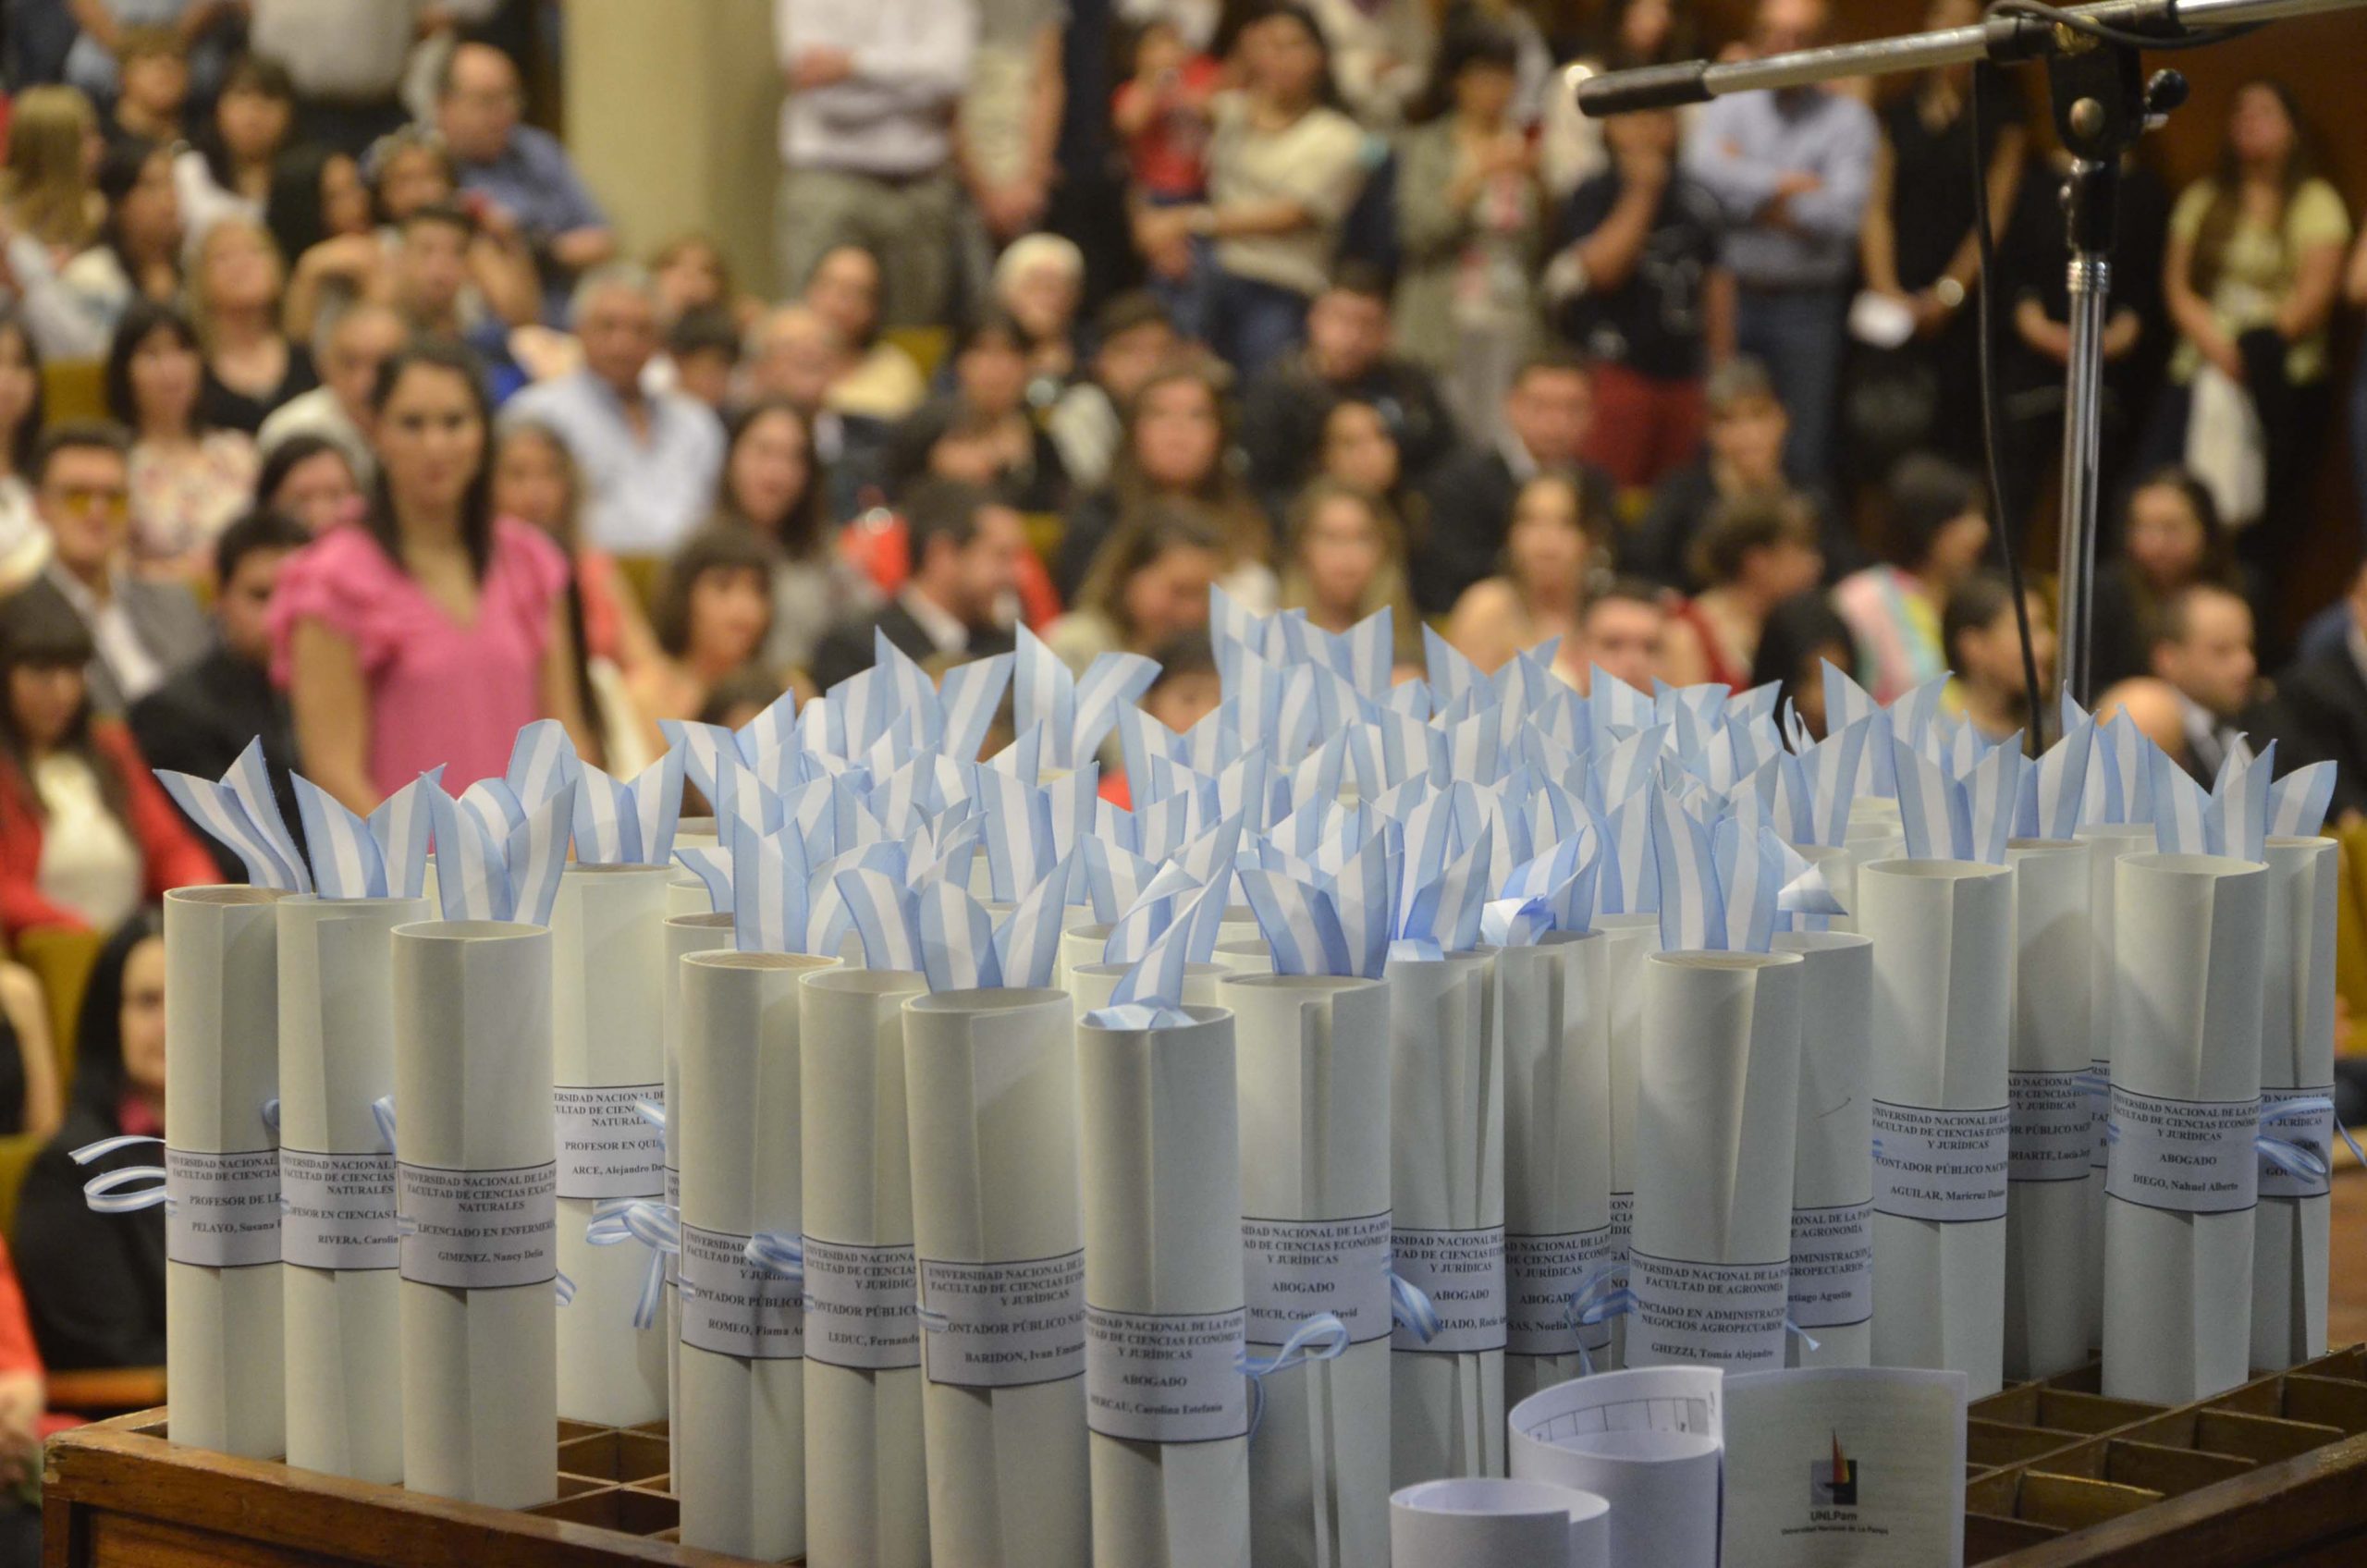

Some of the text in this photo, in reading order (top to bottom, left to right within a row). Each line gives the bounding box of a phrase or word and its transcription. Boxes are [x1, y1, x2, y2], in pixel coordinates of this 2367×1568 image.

[2165, 1106, 2219, 1117] NACIONAL
[2236, 1108, 2248, 1116] LA
[1935, 1117, 1987, 1126] NACIONAL
[1989, 1116, 1998, 1124] DE
[2150, 1116, 2164, 1124] DE
[2166, 1119, 2216, 1130] CIENCIAS
[2277, 1117, 2323, 1127] JURÍDICAS
[1872, 1120, 1918, 1134] FACULTAD
[1919, 1128, 1934, 1137] DE
[1937, 1129, 1984, 1137] CIENCIAS
[2166, 1130, 2222, 1141] JURÍDICAS
[565, 1141, 619, 1151] PROFESOR
[1928, 1140, 1990, 1150] Y JURÍDICAS
[218, 1158, 277, 1169] NACIONAL
[332, 1161, 390, 1170] NACIONAL
[2160, 1154, 2217, 1166] ABOGADO
[573, 1165, 649, 1176] ARCE, Alejandro
[1935, 1163, 1983, 1174] PÚBLICO
[232, 1169, 280, 1181] CIENCIA
[325, 1173, 339, 1182] DE
[341, 1173, 395, 1182] CIENCIAS
[463, 1177, 522, 1188] NACIONAL
[524, 1175, 536, 1184] DE
[2133, 1174, 2238, 1191] DIEGO, Nahuel Alberto
[327, 1185, 394, 1194] NATURALES
[407, 1184, 525, 1200] FACULTAD DE CIENCIAS
[1890, 1185, 1944, 1201] AGUILAR,
[1945, 1191, 1986, 1200] Maricruz
[190, 1195, 245, 1206] PROFESOR
[250, 1194, 264, 1204] DE
[459, 1201, 525, 1213] NATURALES
[337, 1210, 390, 1219] CIENCIAS
[1829, 1213, 1856, 1223] DE LA
[192, 1221, 237, 1233] PELAYO,
[239, 1223, 274, 1231] Susana
[418, 1223, 497, 1238] LICENCIADO EN
[1272, 1228, 1334, 1238] NACIONAL
[1336, 1227, 1350, 1235] DE
[1354, 1226, 1367, 1235] LA
[1801, 1224, 1862, 1238] AGRONOMÍA
[318, 1235, 398, 1244] RIVERA, Carolin
[1437, 1237, 1489, 1246] NACIONAL
[1276, 1242, 1331, 1251] CIENCIAS
[1520, 1242, 1577, 1252] NACIONAL
[1580, 1239, 1590, 1247] DE
[437, 1249, 543, 1263] GIMENEZ, Nancy Delia
[732, 1256, 746, 1265] DE
[861, 1253, 914, 1263] NACIONA
[1268, 1255, 1339, 1265] Y JURÍDICAS
[1421, 1251, 1437, 1259] DE
[1440, 1250, 1488, 1260] CIENCIAS
[1506, 1256, 1576, 1266] DE CIENCIAS
[847, 1267, 860, 1275] DE
[1006, 1265, 1062, 1278] NACIONAL
[1430, 1262, 1491, 1273] Y JURÍDICAS
[1515, 1267, 1583, 1279] Y JURÍDICAS
[740, 1270, 747, 1279] Y
[1692, 1270, 1749, 1280] NACIONAL
[1754, 1270, 1767, 1280] DE
[855, 1280, 863, 1289] Y
[931, 1281, 987, 1293] FACULTAD
[990, 1283, 1006, 1293] DE
[1010, 1278, 1063, 1292] CIENCIAS
[1272, 1282, 1335, 1293] ABOGADO
[1645, 1277, 1704, 1292] FACULTAD
[1000, 1289, 1070, 1306] Y JURÍDICAS
[1433, 1290, 1489, 1301] ABOGADO
[1520, 1294, 1572, 1305] ABOGAD
[1687, 1309, 1703, 1317] EN
[708, 1318, 753, 1335] ROMEO,
[948, 1317, 1066, 1335] ONTADOR PÚBLICO
[1125, 1320, 1186, 1332] NACIONAL
[1192, 1321, 1206, 1330] DE
[1537, 1320, 1567, 1330] Noelia
[1641, 1314, 1698, 1331] NEGOCIOS
[828, 1332, 867, 1346] LEDUC,
[1110, 1332, 1123, 1342] DE
[1128, 1334, 1185, 1346] CIENCIAS
[964, 1352, 1027, 1364] BARIDON,
[1030, 1348, 1052, 1361] Ivan
[1118, 1347, 1193, 1360] Y JURÍDICAS
[1651, 1342, 1697, 1358] GHEZZI,
[1699, 1349, 1731, 1359] Tomás
[1122, 1374, 1187, 1386] ABOGADO
[1135, 1404, 1179, 1415] Carolina
[1810, 1512, 1857, 1522] UNLPam
